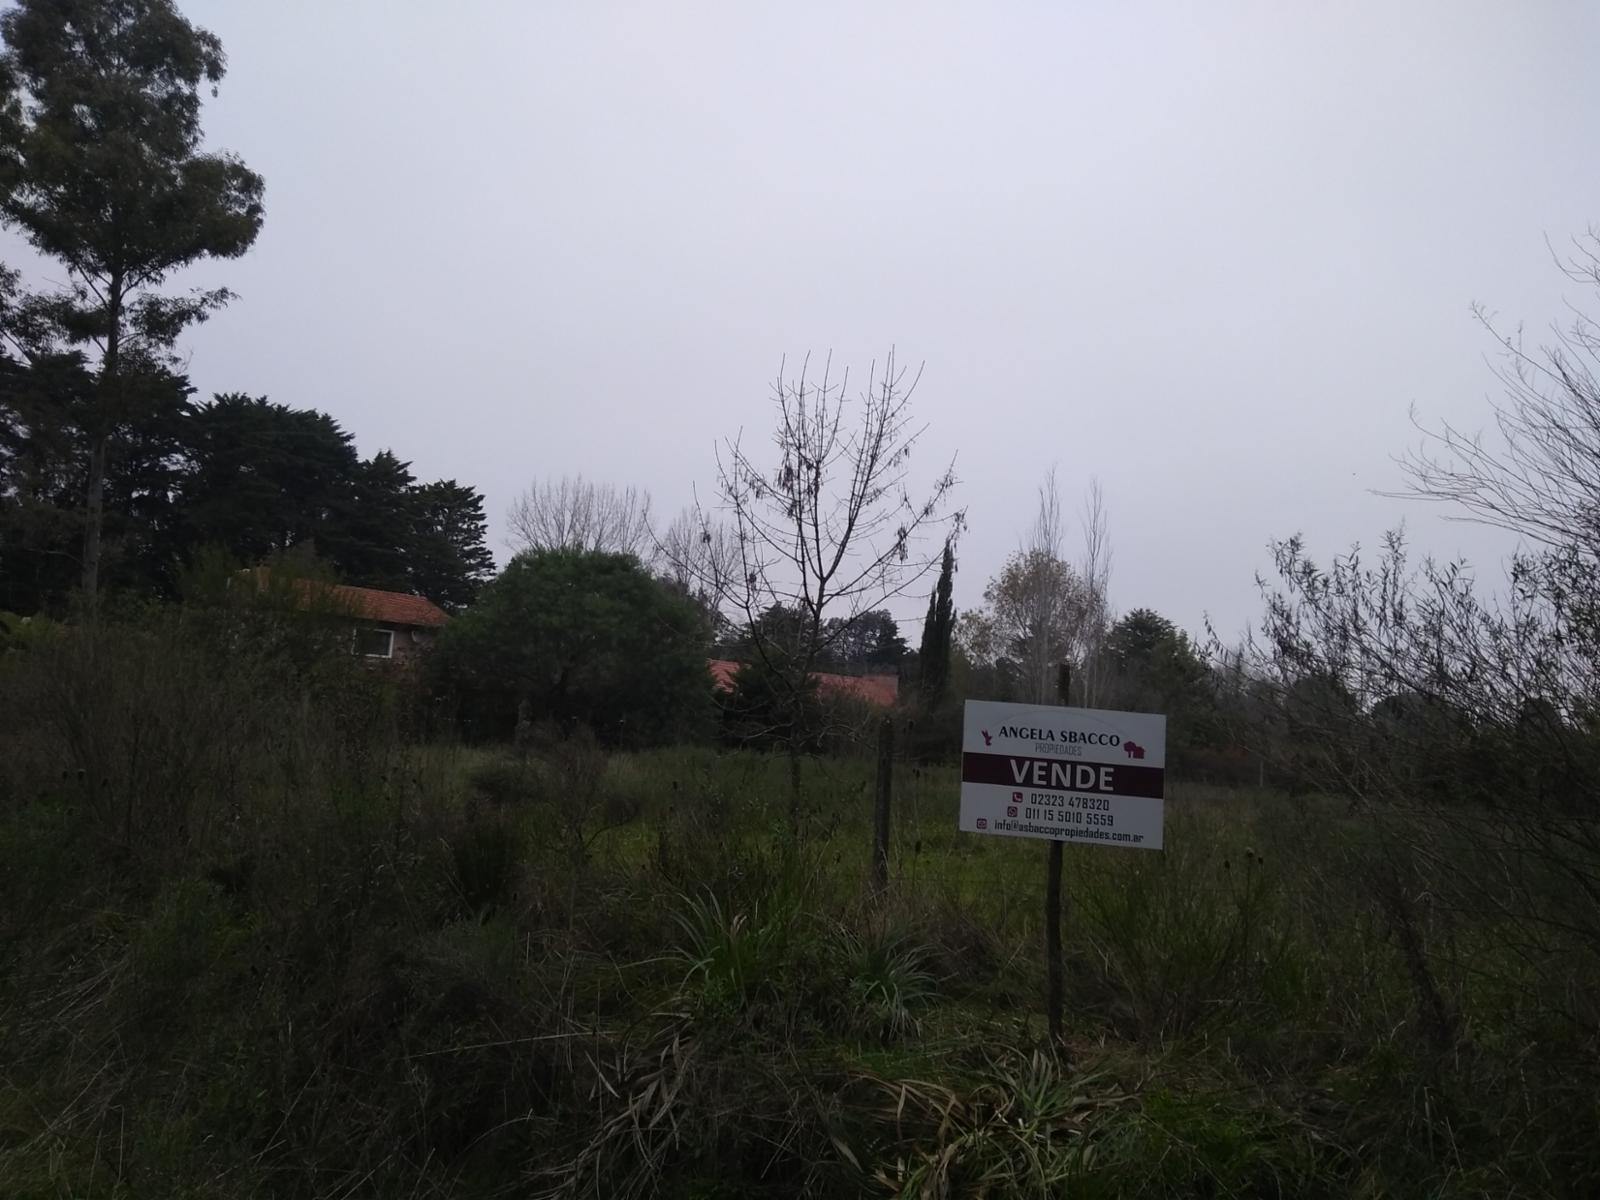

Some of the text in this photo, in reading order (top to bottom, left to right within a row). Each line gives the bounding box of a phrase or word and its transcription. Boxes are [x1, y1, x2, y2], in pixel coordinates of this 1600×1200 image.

[999, 725, 1120, 747] ANGELA SBACCO
[1035, 742, 1082, 757] PROPIEDADES
[1010, 758, 1114, 791] VENDE
[1031, 793, 1109, 811] 02323 478320
[1025, 807, 1114, 827] 011 15 5010 5559
[994, 819, 1144, 843] info@asbaccopropiedades.com.ar
